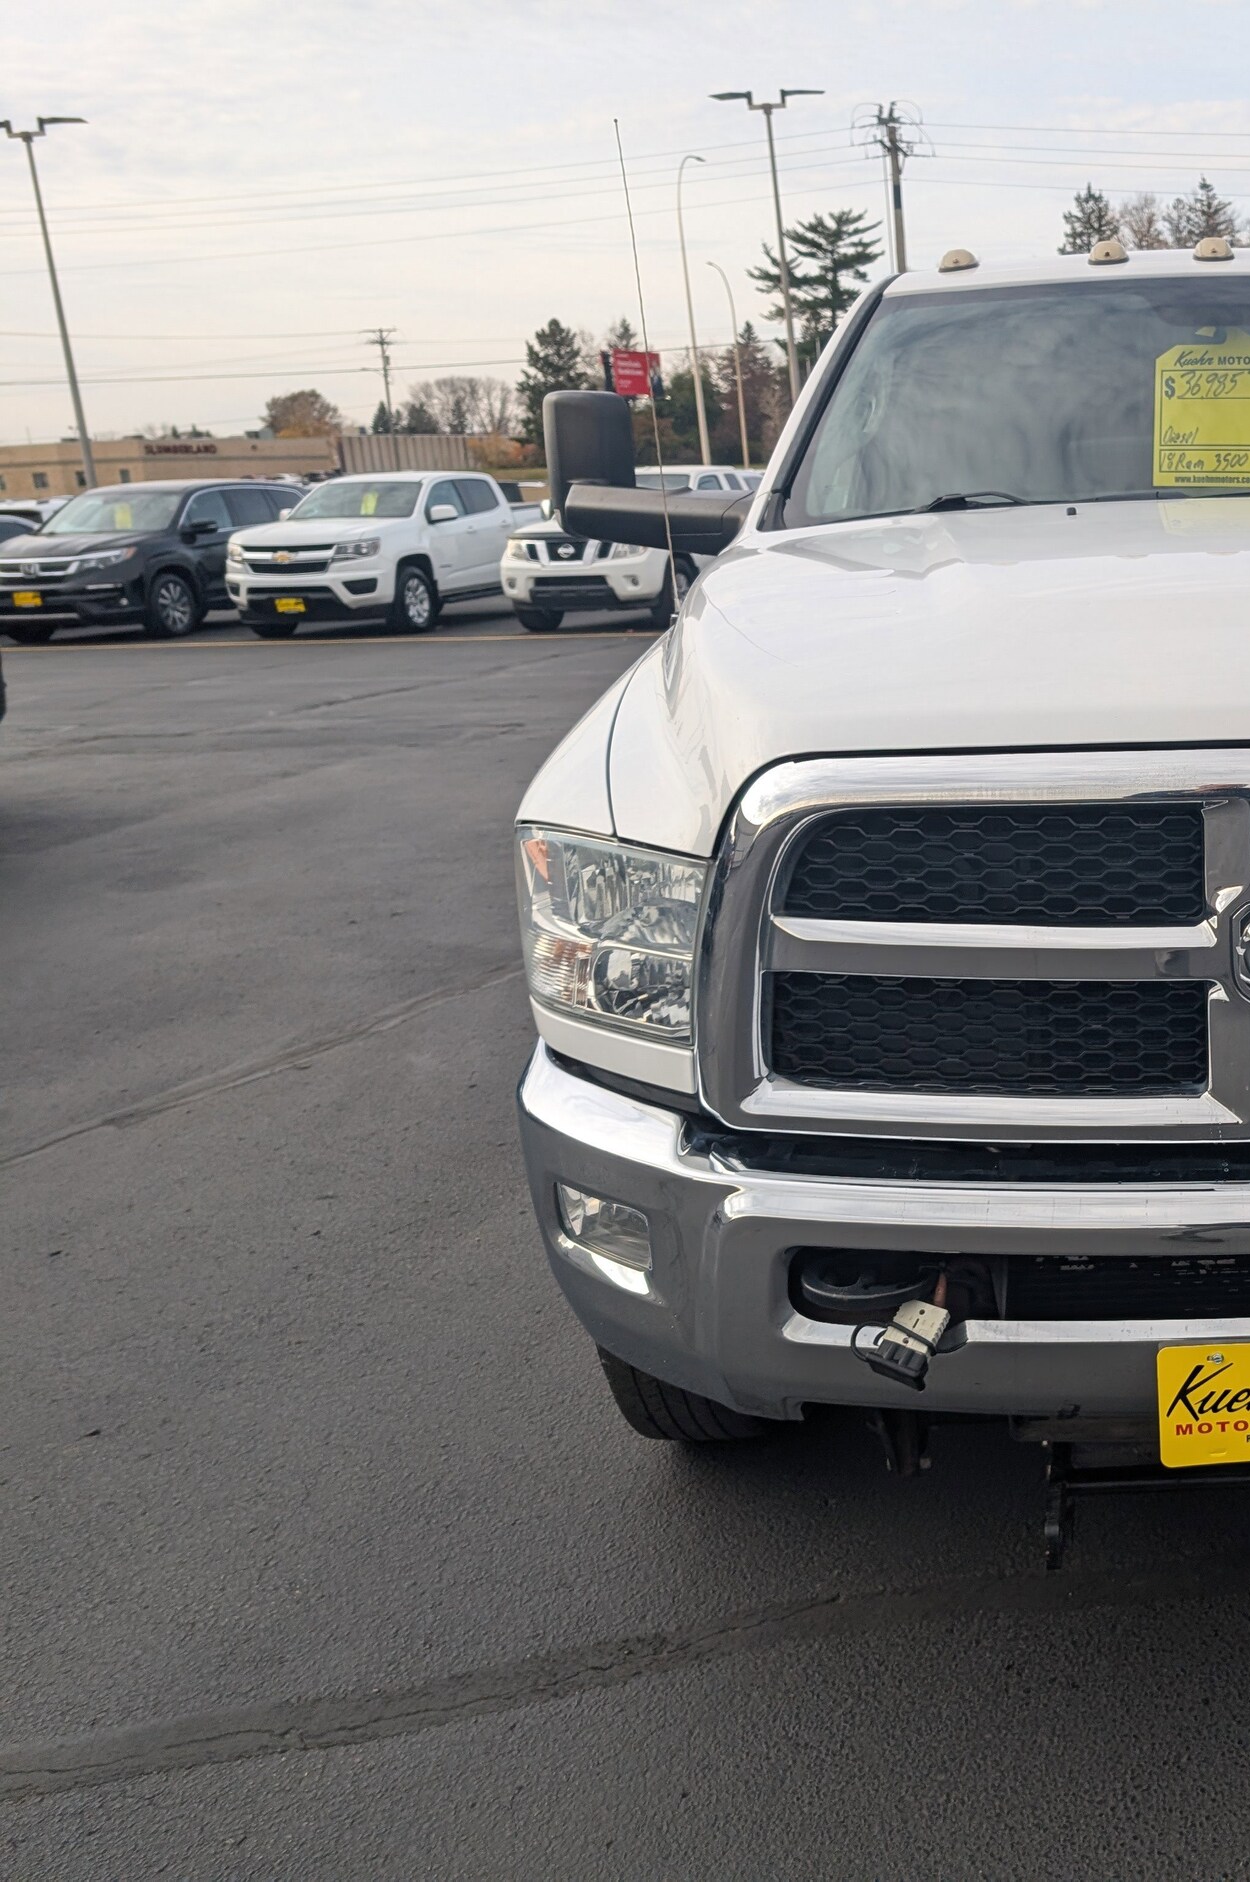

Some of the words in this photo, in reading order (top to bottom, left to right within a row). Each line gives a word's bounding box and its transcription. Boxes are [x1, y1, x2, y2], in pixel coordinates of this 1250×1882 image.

[1174, 350, 1214, 368] Kuehn
[1162, 426, 1199, 445] Diesel
[1211, 452, 1249, 472] 3500
